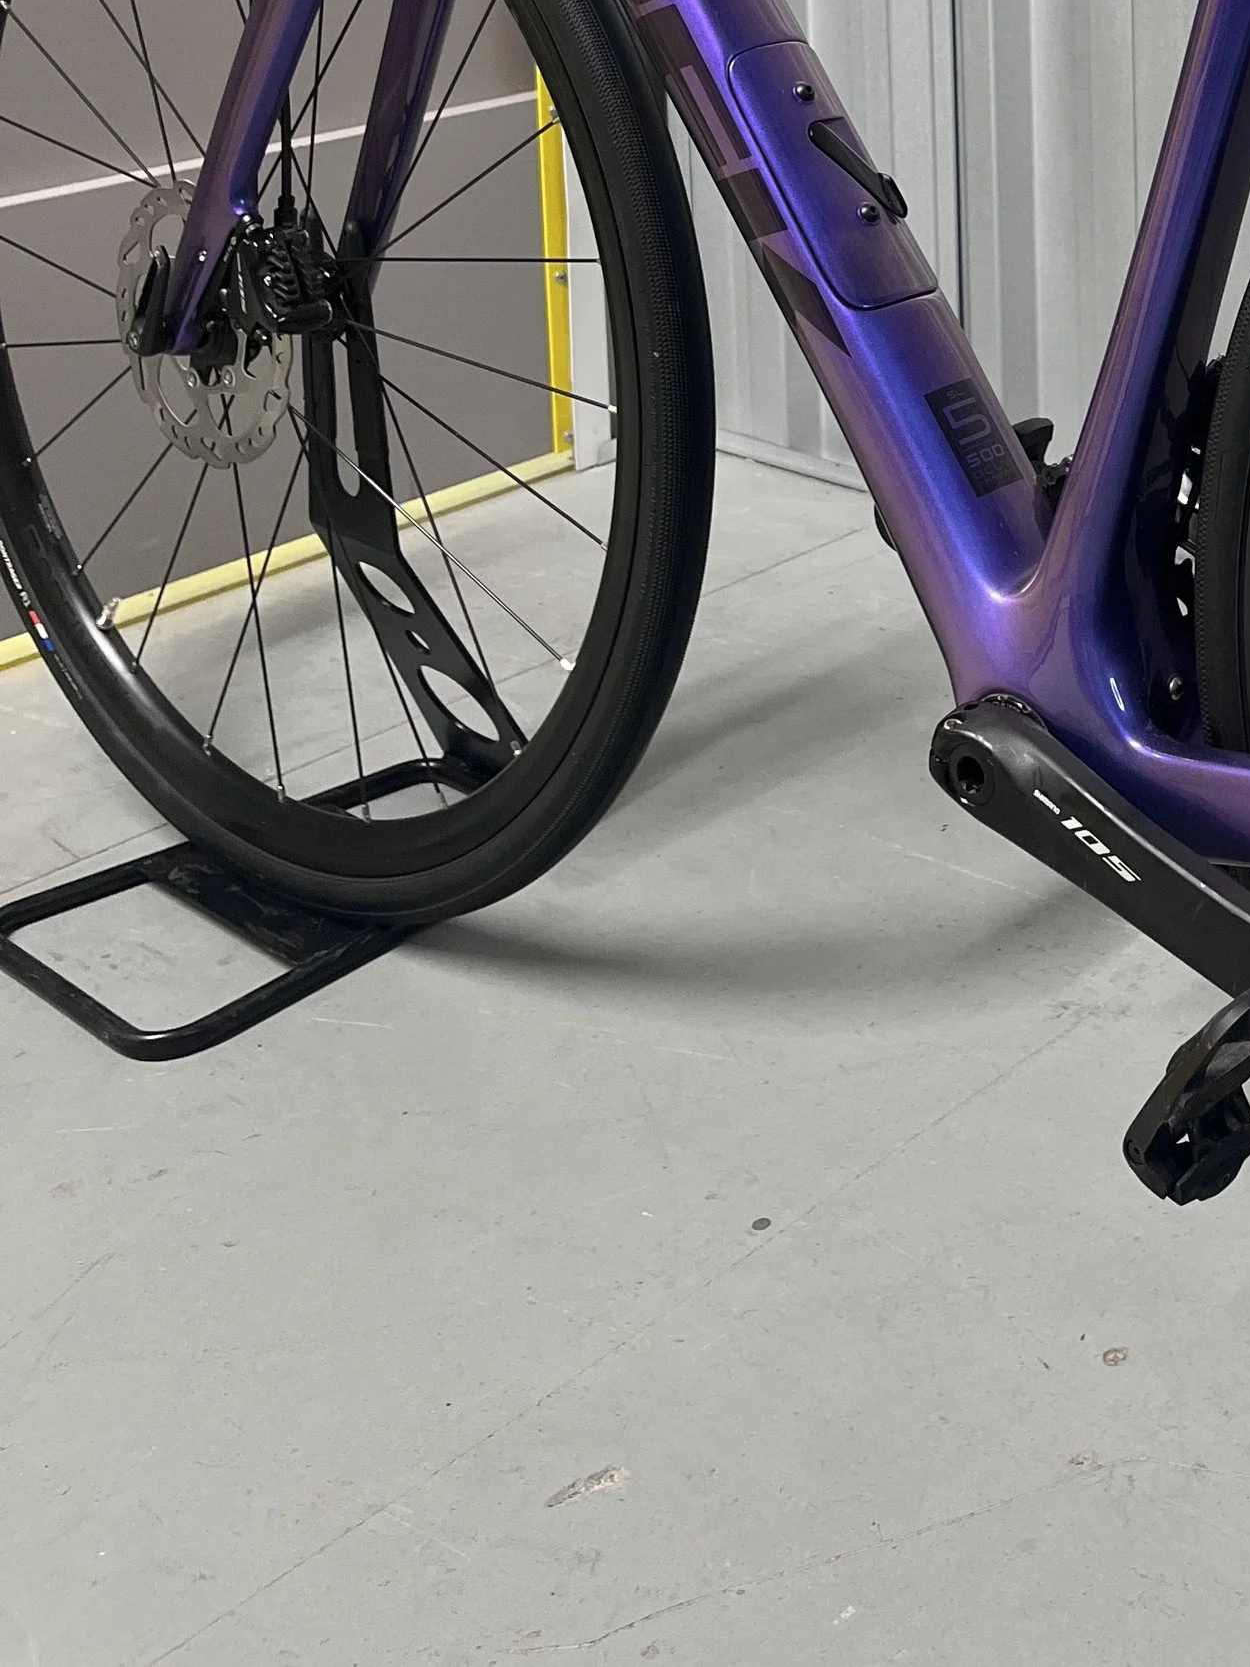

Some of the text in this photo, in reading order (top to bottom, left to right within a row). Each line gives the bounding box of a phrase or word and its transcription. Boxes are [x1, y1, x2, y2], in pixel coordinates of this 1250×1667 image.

[943, 396, 991, 445] 5
[967, 444, 1004, 467] 500
[1060, 816, 1142, 882] 105
